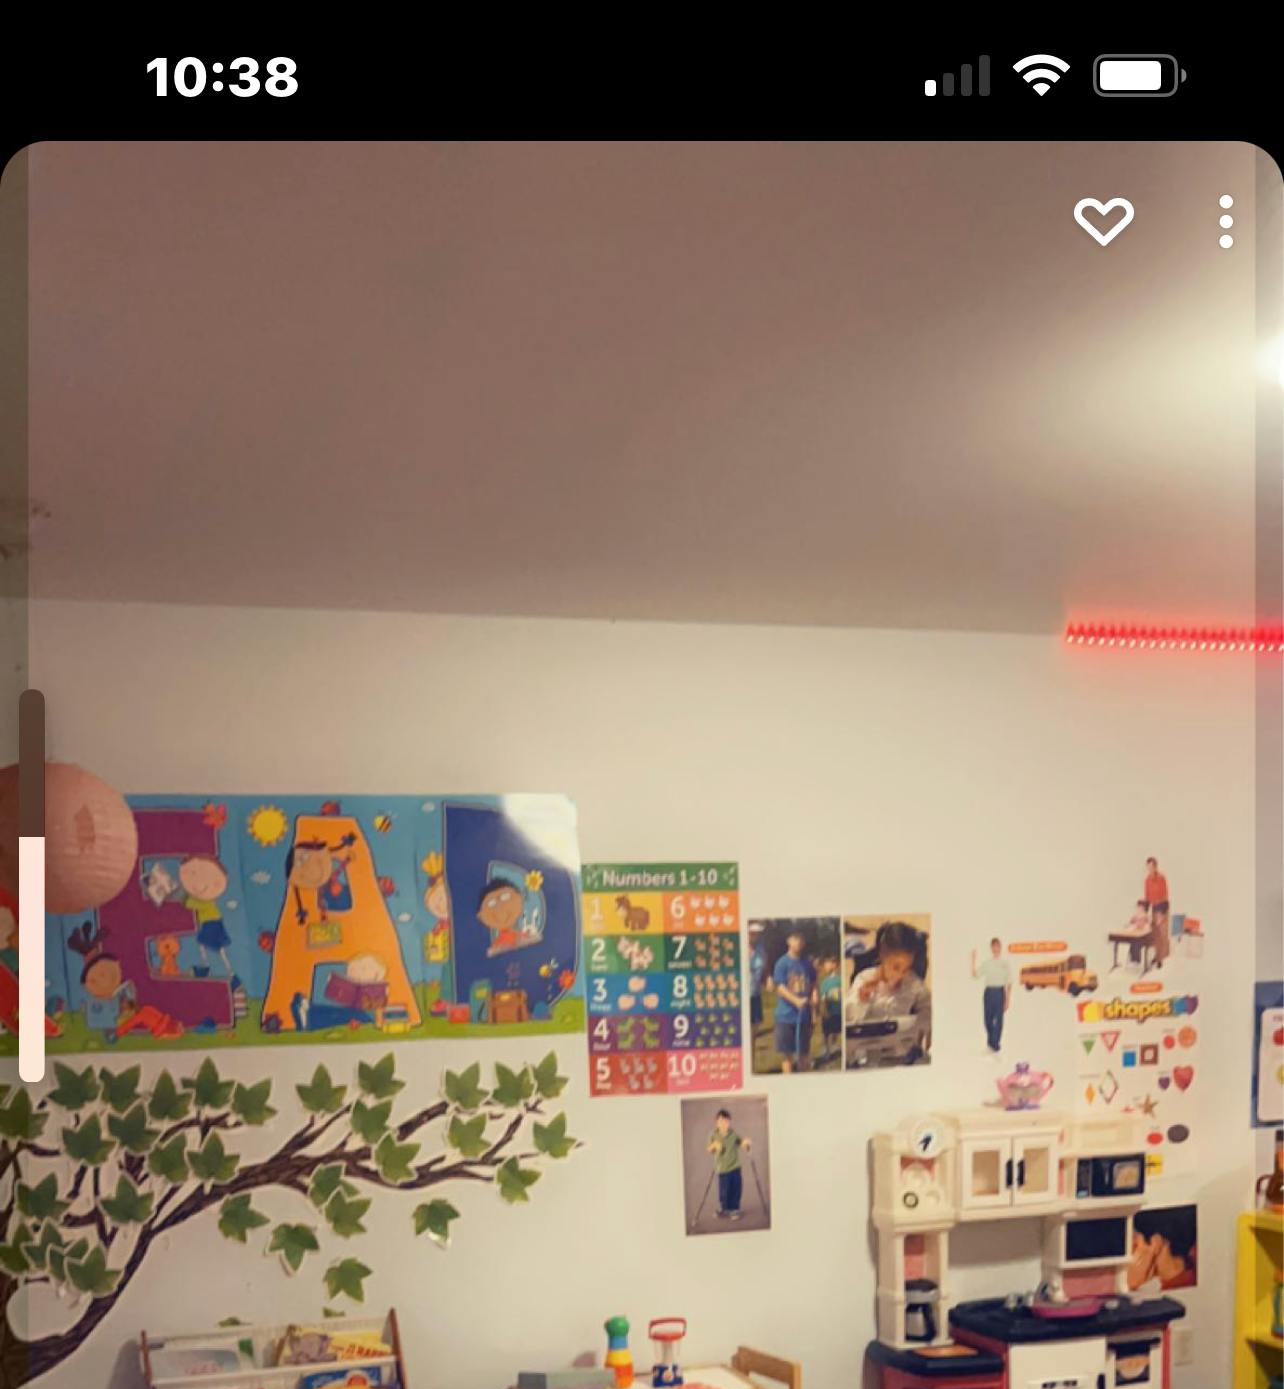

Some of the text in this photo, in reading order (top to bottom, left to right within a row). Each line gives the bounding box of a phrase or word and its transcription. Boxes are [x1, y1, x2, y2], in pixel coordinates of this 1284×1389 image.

[603, 869, 675, 886] Numbers
[591, 897, 603, 920] 1
[670, 896, 685, 919] 6
[591, 938, 606, 961] 2
[672, 936, 687, 959] 7
[593, 978, 607, 1001] 3
[673, 975, 688, 998] 8
[1103, 998, 1172, 1024] shapes
[593, 1017, 609, 1040] 4
[673, 1014, 689, 1038] 9
[596, 1057, 610, 1080] 5
[668, 1055, 696, 1077] 10
